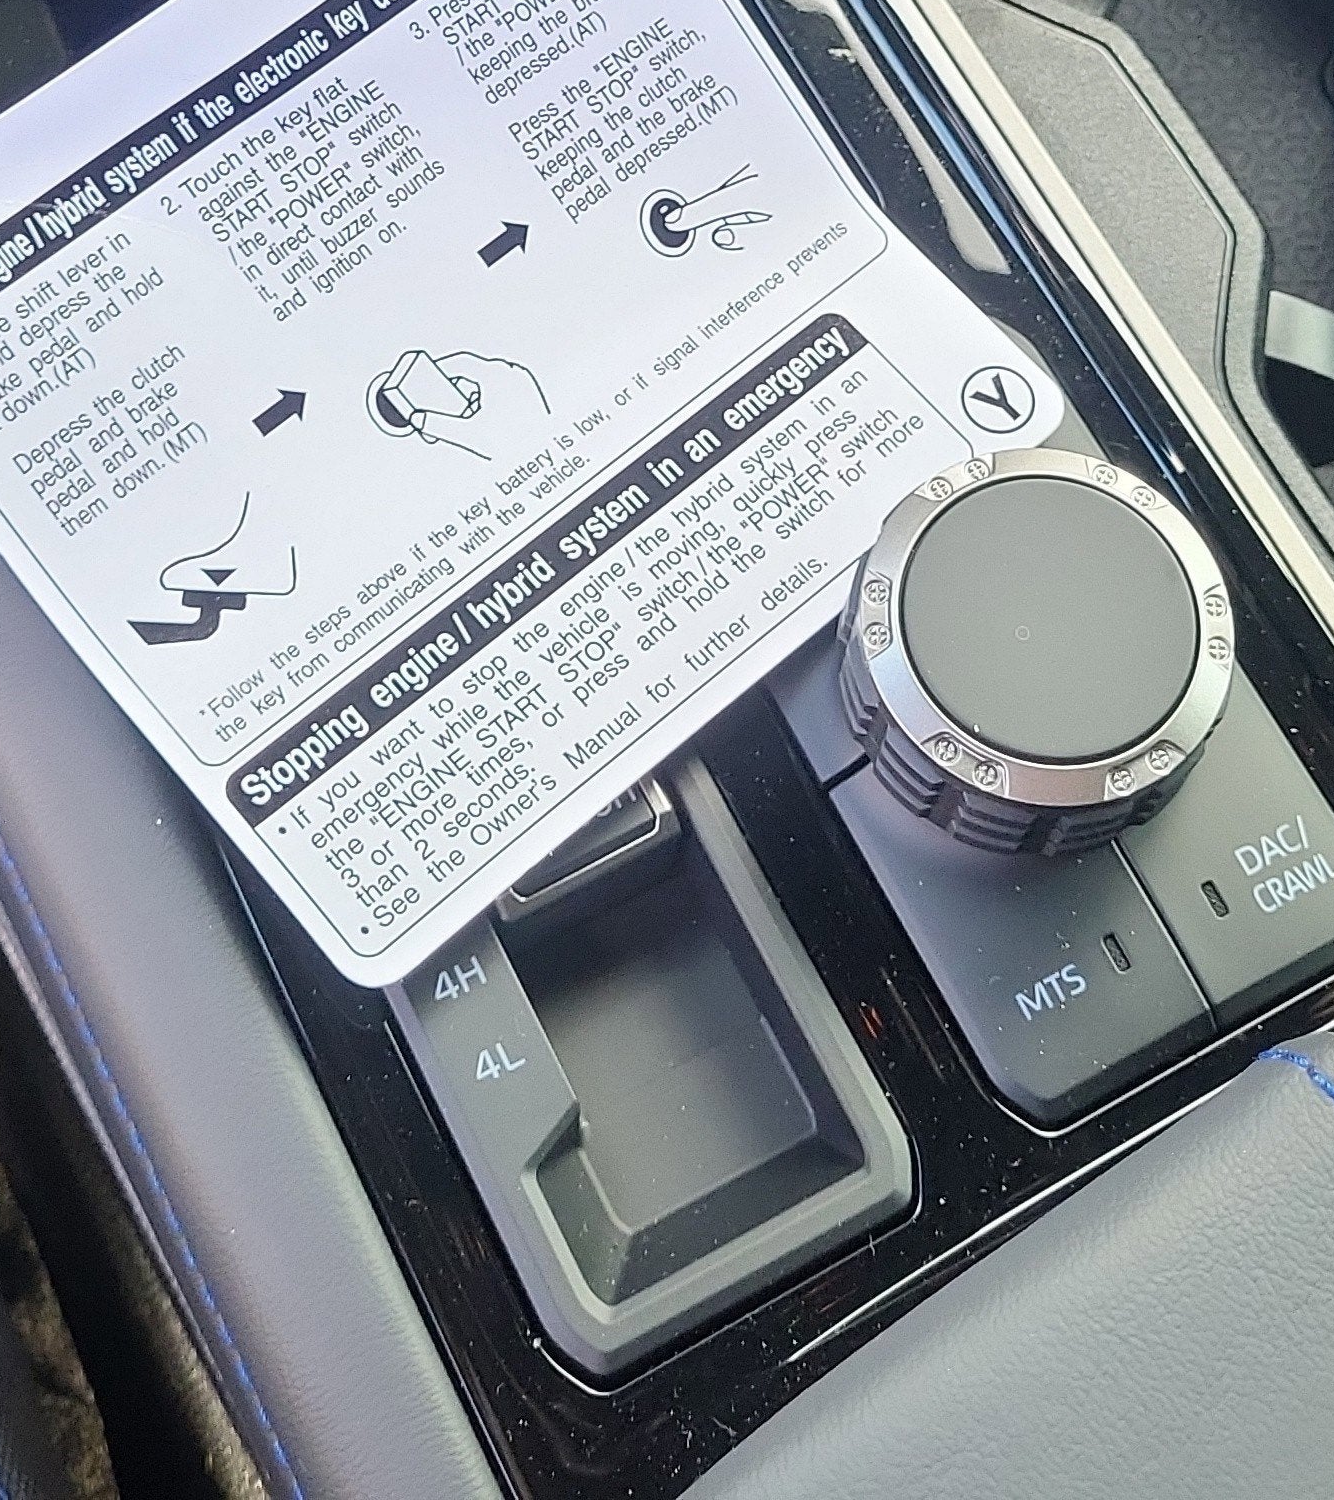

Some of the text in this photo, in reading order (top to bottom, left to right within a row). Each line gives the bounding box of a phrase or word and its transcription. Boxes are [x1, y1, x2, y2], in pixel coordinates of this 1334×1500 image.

[103, 132, 180, 194] system
[175, 111, 199, 144] if
[192, 94, 235, 129] the
[234, 29, 330, 104] electronic
[323, 0, 370, 40] key
[466, 31, 538, 86] keeping
[521, 108, 580, 161] START
[648, 28, 707, 72] switch,
[177, 76, 349, 199] Touch the key flat
[211, 187, 273, 243] START
[347, 101, 403, 147] switch
[360, 123, 422, 169] switch,
[507, 102, 560, 144] Press
[533, 66, 688, 182] keeping clutch
[550, 74, 717, 206] pedal and brake
[198, 166, 265, 222] against
[266, 145, 424, 266] direct contact with
[281, 160, 445, 285] until buzzer sounds
[15, 280, 61, 320] shift
[56, 245, 108, 288] lever
[19, 290, 92, 347] depress
[27, 326, 80, 379] pedal
[85, 296, 122, 333] and
[120, 266, 164, 306] hold
[272, 243, 373, 322] and ignition
[12, 345, 186, 475] Depress clutch
[29, 382, 178, 501] pedal brake
[304, 605, 352, 645] steps
[356, 563, 407, 605] above
[457, 496, 492, 525] key
[494, 448, 554, 496] battery
[572, 409, 611, 436] low,
[653, 334, 700, 376] signal
[697, 272, 785, 340] interference
[786, 222, 848, 277] prevents
[968, 372, 1021, 421] Y
[45, 406, 180, 521] pedal hold
[240, 321, 850, 806] Stopping system in an emergency
[249, 455, 591, 715] key from communicating with vehicle.
[289, 370, 869, 830] If you want to stop the hybrid system in an
[310, 410, 863, 849] emergency while the vehicle is moving, quickly press
[324, 838, 365, 871] the
[475, 682, 548, 749] START
[840, 409, 899, 459] switch
[340, 415, 924, 889] 3 or more times, or press and hold the switch for more
[372, 887, 421, 928] See
[425, 849, 466, 883] the
[469, 774, 557, 846] Owner's
[562, 701, 642, 770] Manual
[644, 673, 677, 704] for
[683, 613, 751, 672] further
[760, 558, 828, 611] details.
[355, 764, 536, 908] than 2 seconds.
[1234, 814, 1310, 877] DAC/
[434, 954, 488, 1001] 4H
[1015, 963, 1087, 1021] MTS
[476, 1042, 527, 1081] 4L
